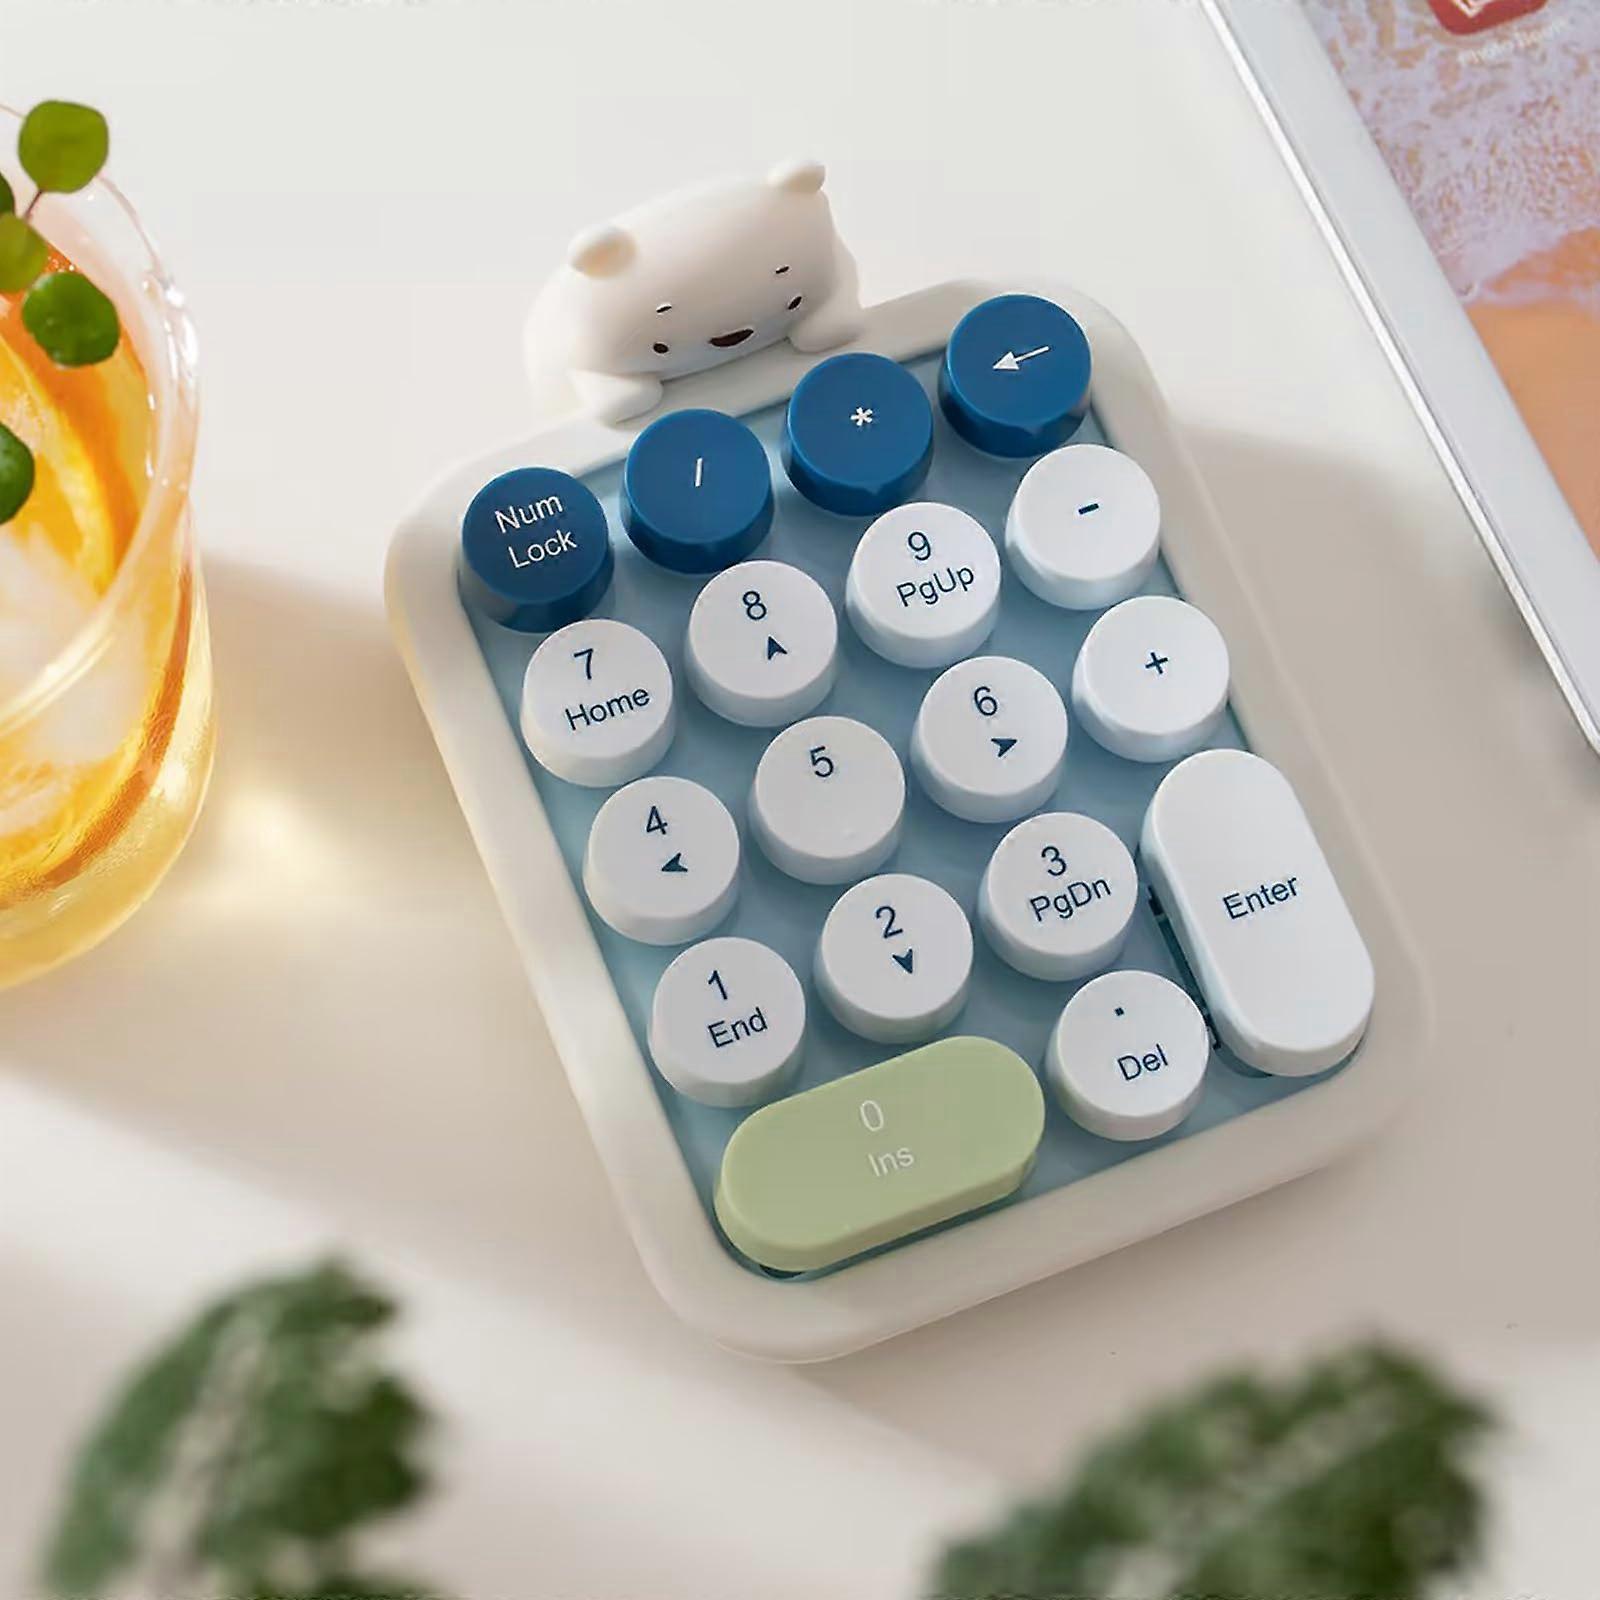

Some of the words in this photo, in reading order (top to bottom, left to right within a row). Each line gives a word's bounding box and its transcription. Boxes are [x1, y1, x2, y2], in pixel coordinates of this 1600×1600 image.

[494, 495, 563, 533] Num
[508, 529, 577, 568] Lock
[908, 532, 931, 561] 9
[897, 566, 974, 607] PgUp
[743, 591, 766, 620] 8
[574, 648, 593, 680] 7
[1146, 652, 1168, 674] +
[565, 689, 649, 730] Home
[974, 686, 997, 716] 6
[810, 746, 833, 777] 5
[647, 806, 667, 835] 4
[1042, 846, 1066, 876] 3
[1030, 877, 1110, 921] PgDn
[1222, 877, 1298, 919] Enter
[876, 906, 903, 938] 2
[708, 970, 727, 1000] 1
[708, 1007, 767, 1047] End
[1118, 1044, 1168, 1080] Del
[860, 1100, 884, 1131] 0
[869, 1148, 914, 1176] Ins
